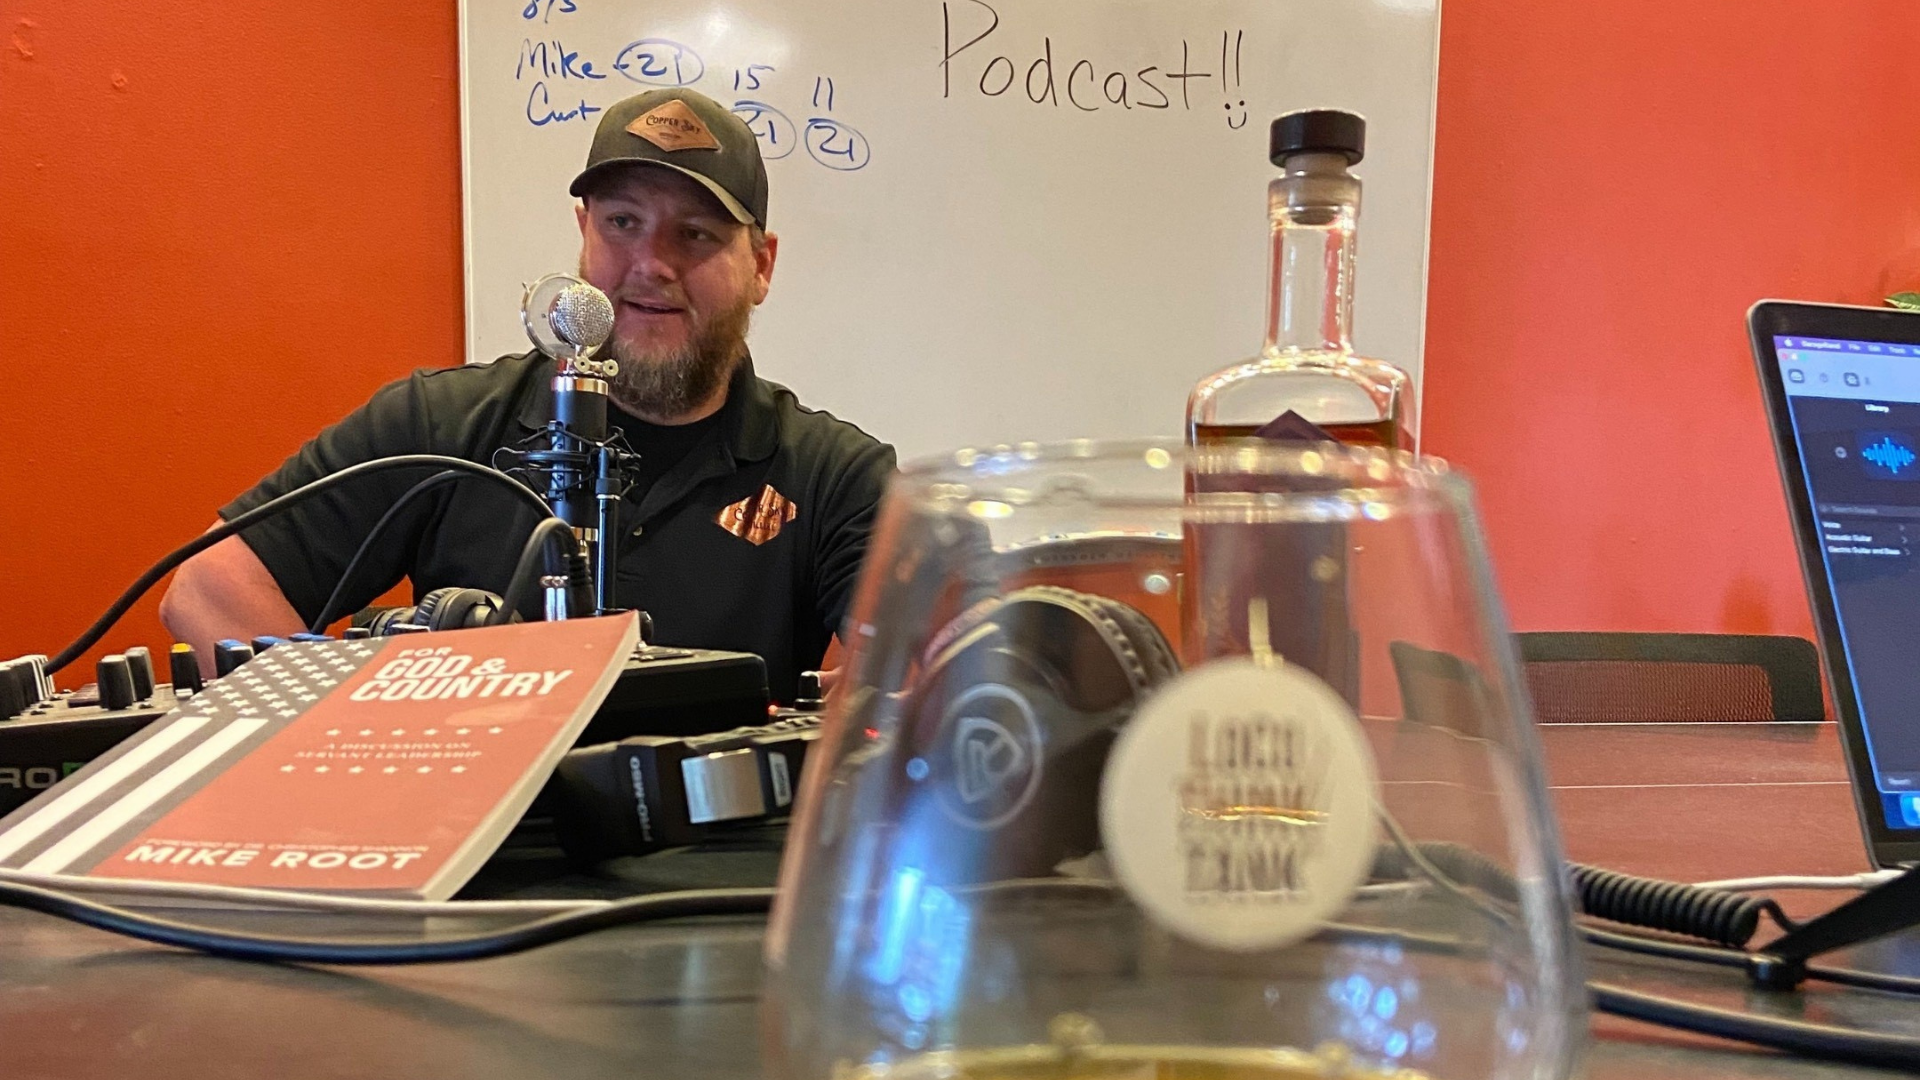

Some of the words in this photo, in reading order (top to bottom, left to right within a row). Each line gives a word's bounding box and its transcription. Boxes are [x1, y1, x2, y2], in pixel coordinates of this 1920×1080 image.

[516, 38, 607, 79] Mike
[731, 64, 775, 91] 15
[814, 125, 854, 162] 21
[398, 647, 453, 658] FOR
[374, 655, 473, 679] GOD
[471, 658, 507, 675] &
[349, 669, 574, 702] COUNTRY
[125, 845, 260, 867] MIKE
[270, 850, 422, 870] ROOT
